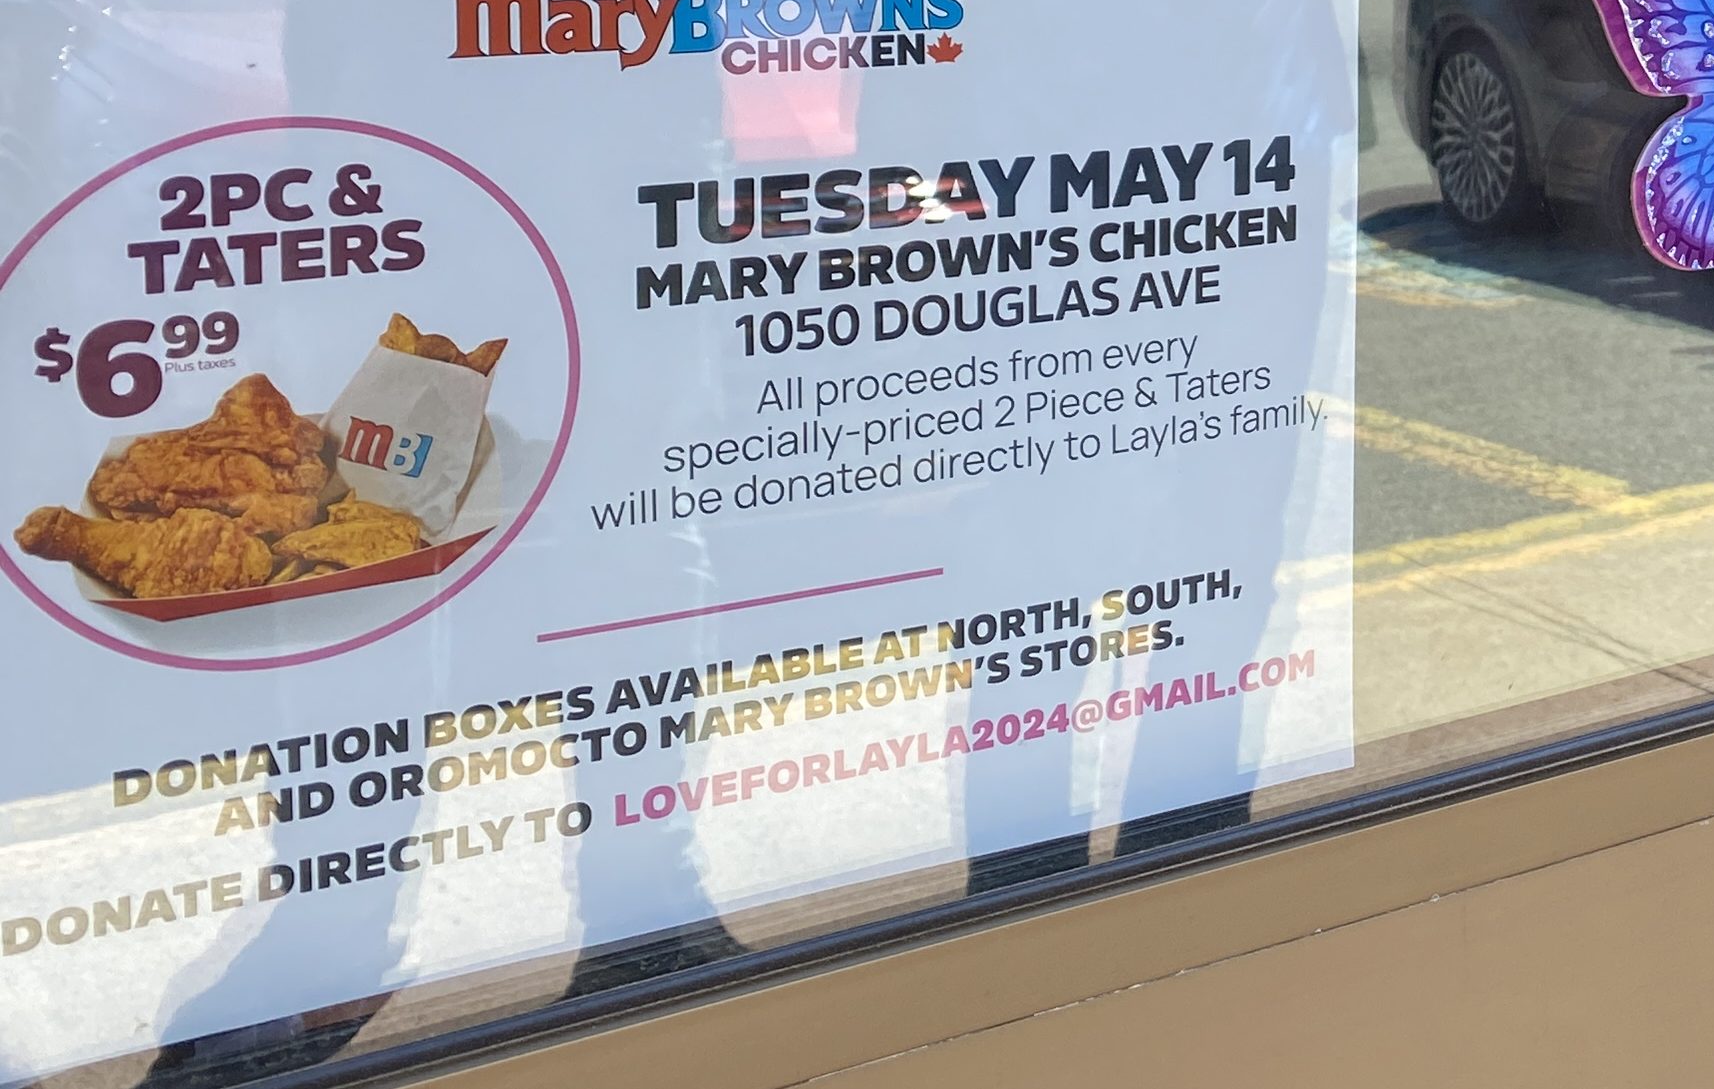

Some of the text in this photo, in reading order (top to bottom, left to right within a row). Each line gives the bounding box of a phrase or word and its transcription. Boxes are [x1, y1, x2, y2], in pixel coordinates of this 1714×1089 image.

[721, 33, 925, 75] CHICKEN
[158, 163, 383, 231] 2PC &
[637, 136, 1295, 248] TUESDAY MAY 14
[127, 218, 426, 295] TATERS
[636, 204, 1298, 310] MARY BROWN'S CHICKEN
[734, 266, 1222, 357] 1050 DOUGLAS AVE
[164, 359, 236, 373] Plus taxes
[756, 335, 1198, 417] All proceeds from every
[590, 394, 1328, 531] will be donated directly to Layla's family.
[662, 362, 1271, 480] specially-priced 2 Piece & Taters
[113, 568, 1243, 808] DONATION BOXES AVAILABLE AT NORTH, SOUTH,
[214, 620, 1185, 836] AND OROMOCTO MARY BROWN'S STORES.
[1, 649, 1316, 956] DONATE DIRECTLY TO LOVEFORLAYLA2024@GMAIL.COM
